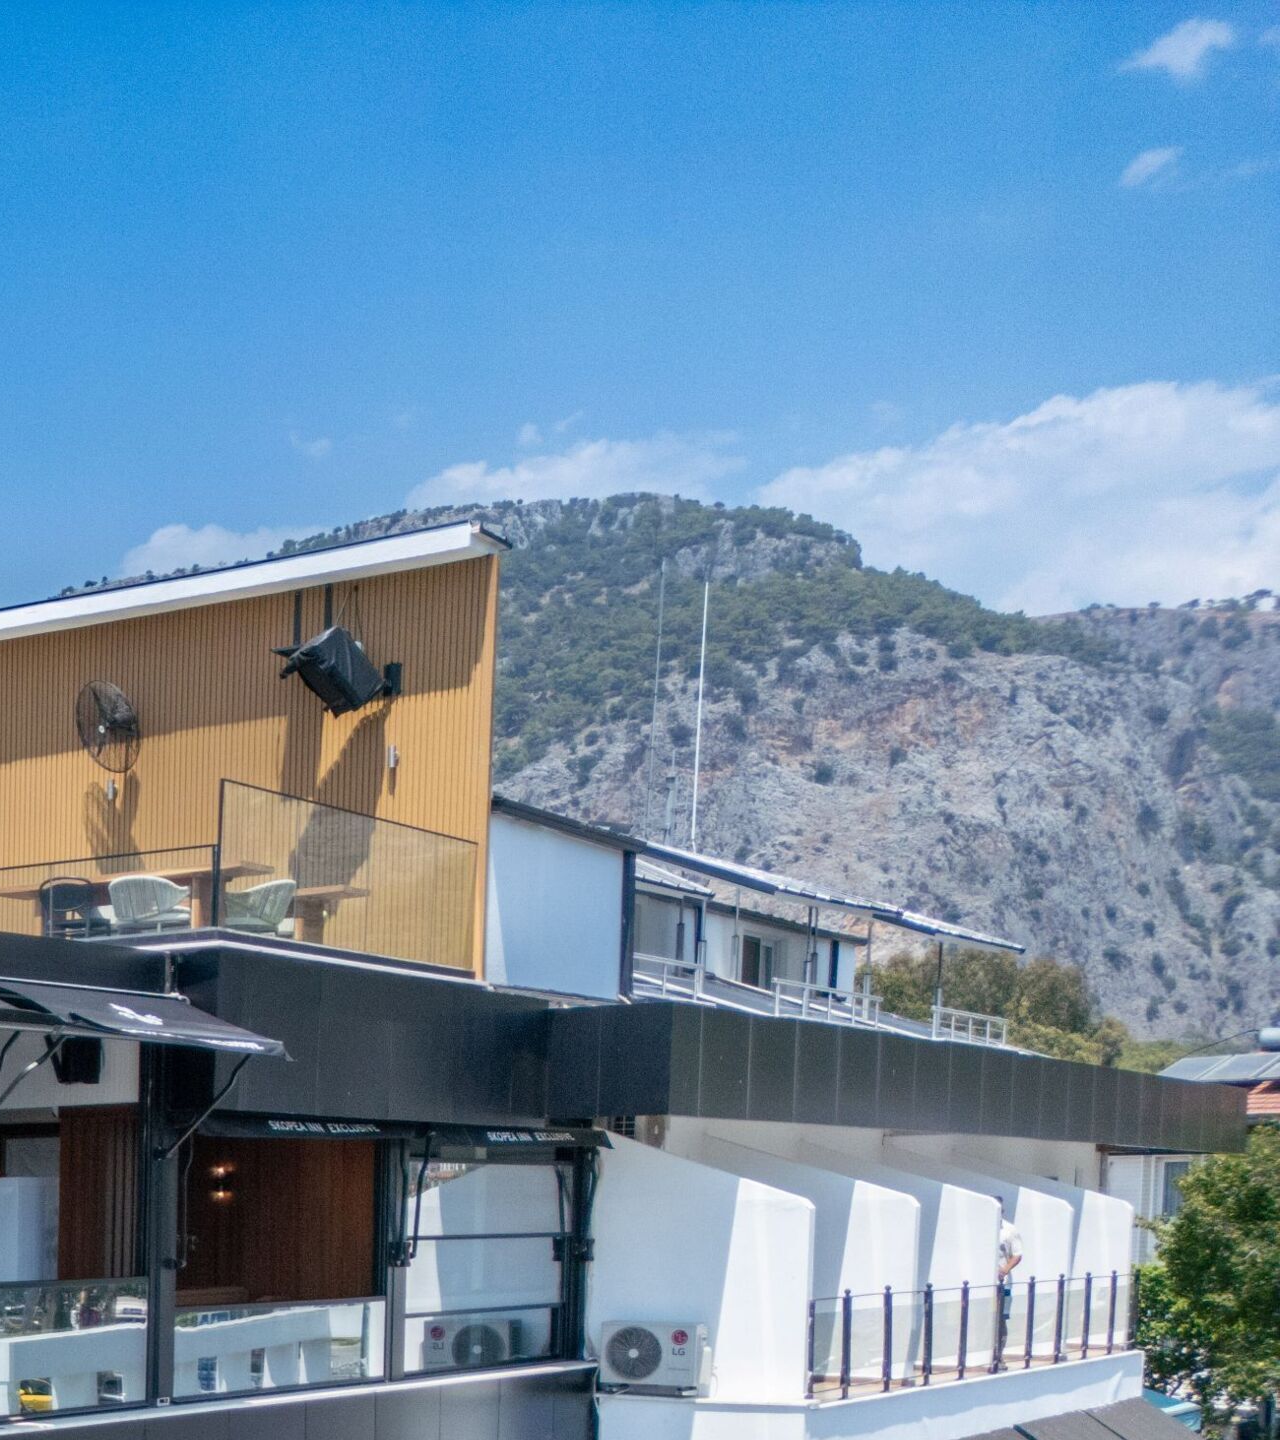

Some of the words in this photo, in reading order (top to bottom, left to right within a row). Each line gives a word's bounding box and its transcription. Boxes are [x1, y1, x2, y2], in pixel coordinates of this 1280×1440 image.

[268, 1120, 308, 1131] SKOPEA
[327, 1123, 380, 1133] EXCLUSIVE
[672, 1347, 686, 1356] LG
